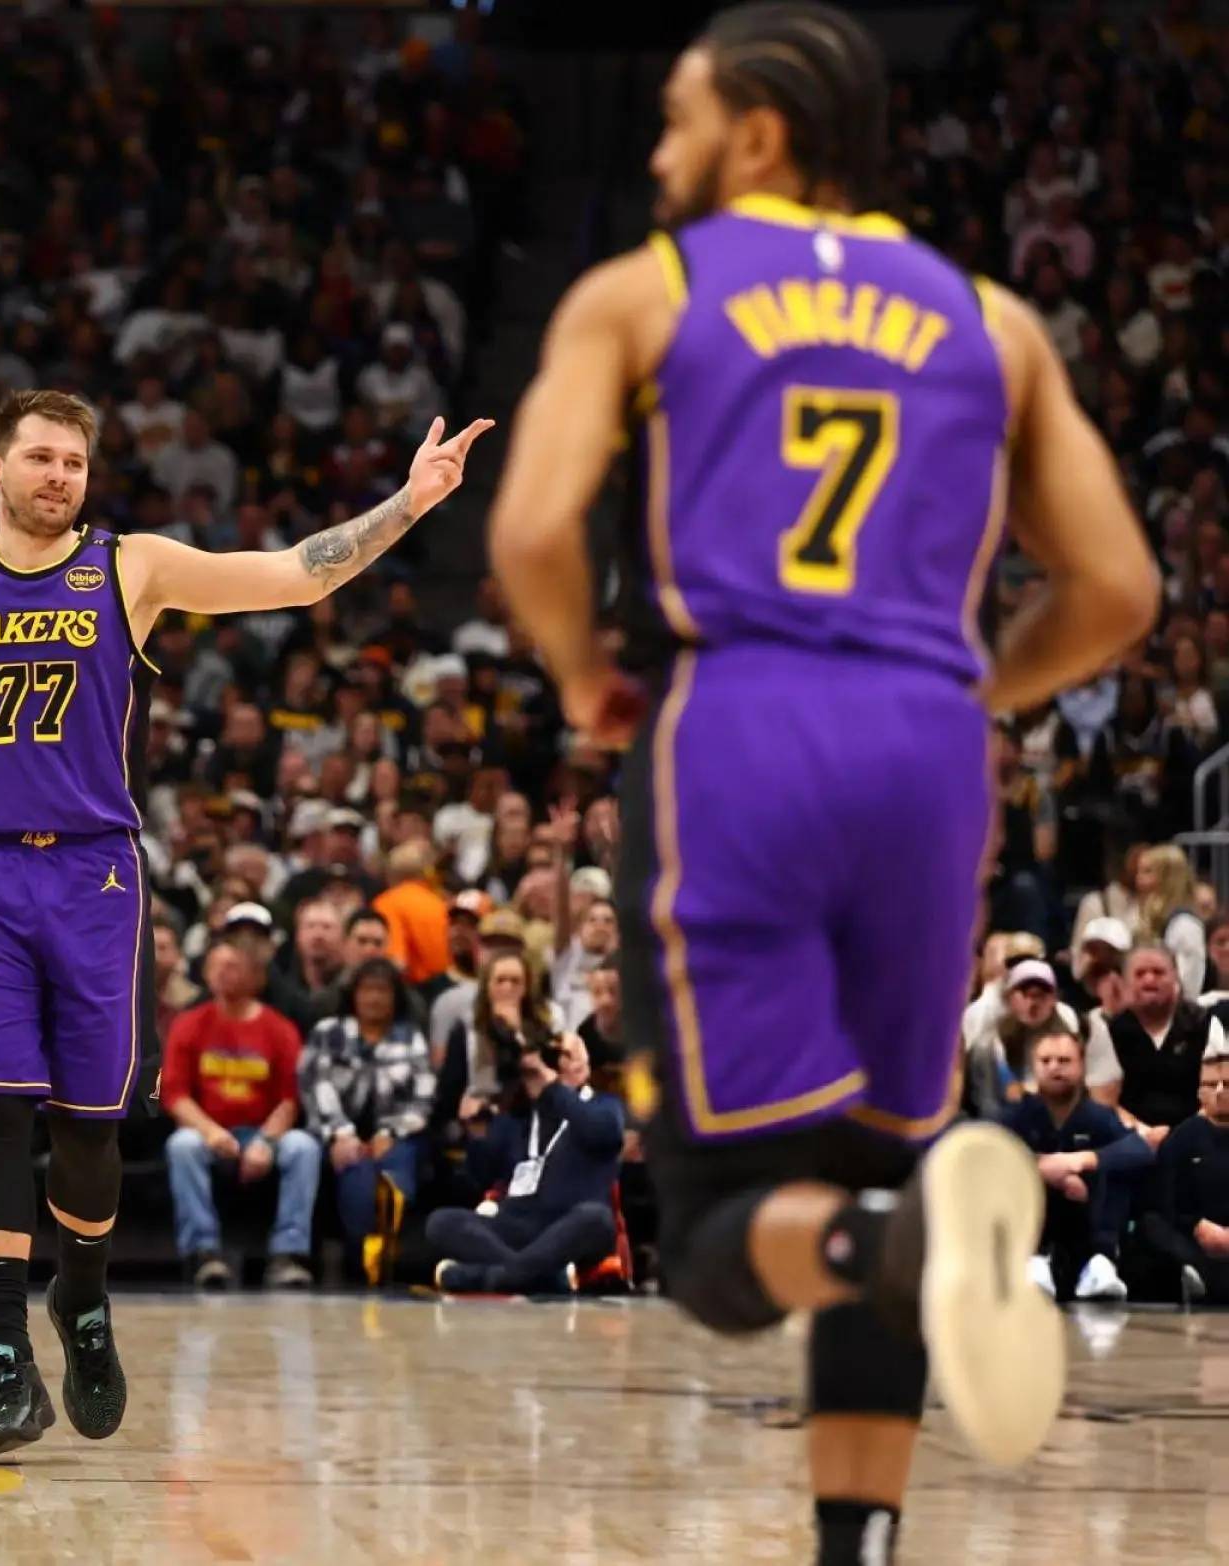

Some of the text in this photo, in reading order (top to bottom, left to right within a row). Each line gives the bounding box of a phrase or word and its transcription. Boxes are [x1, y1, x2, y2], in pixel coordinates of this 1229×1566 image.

[724, 278, 950, 374] VINCENT
[778, 384, 901, 595] 7
[69, 572, 103, 585] bibigo
